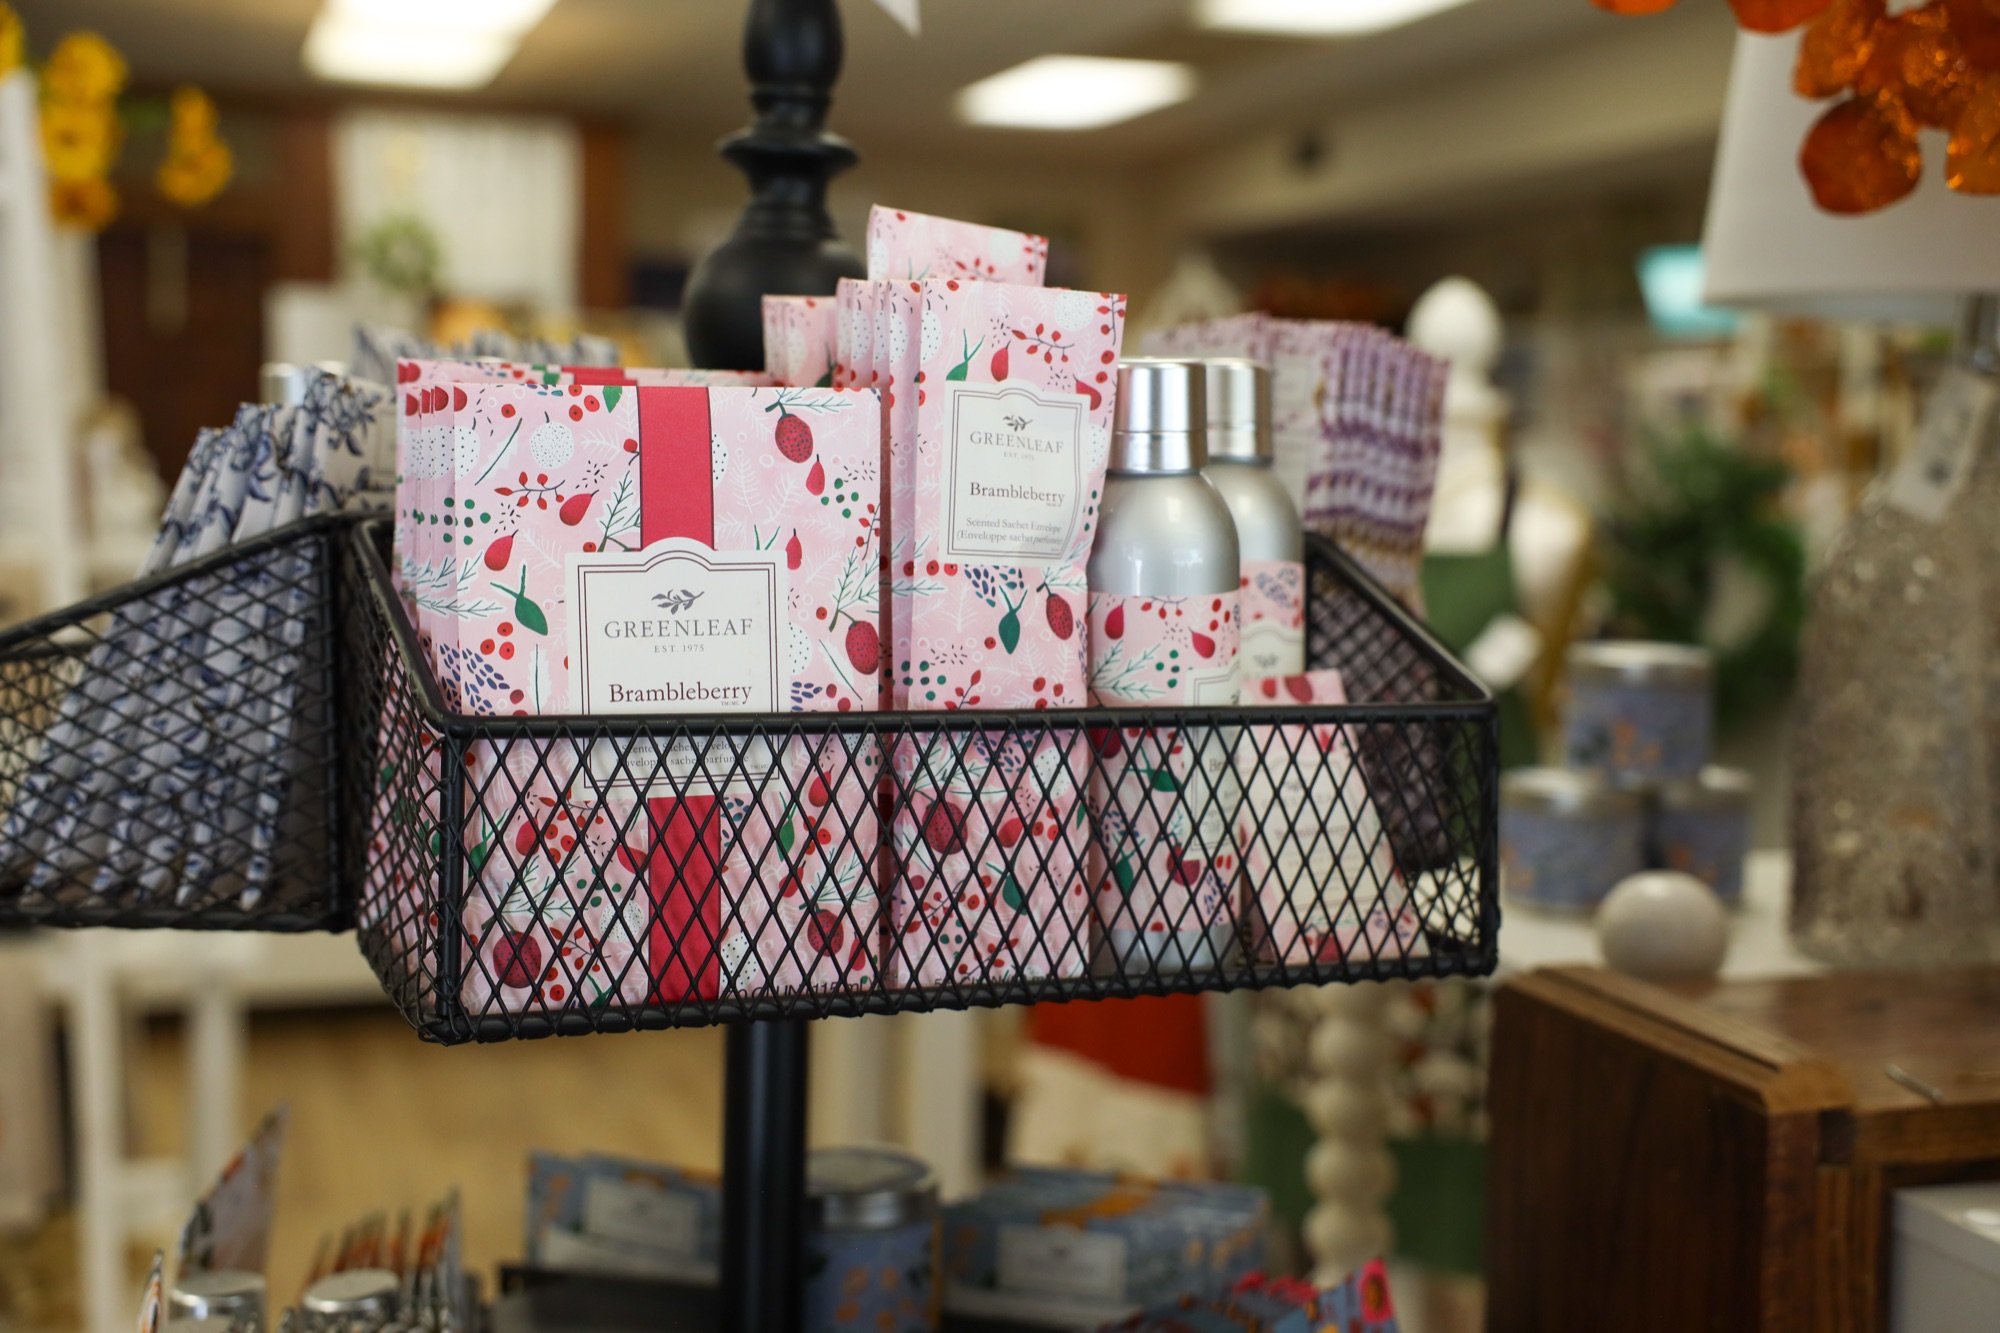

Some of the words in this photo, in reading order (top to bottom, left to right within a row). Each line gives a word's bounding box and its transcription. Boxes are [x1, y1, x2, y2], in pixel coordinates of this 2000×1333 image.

[969, 430, 1064, 454] GREENLEAF
[969, 481, 1065, 507] Brambleberry
[966, 517, 1000, 528] Scented
[1002, 518, 1029, 529] Sachet
[1031, 521, 1062, 535] Envelope
[956, 529, 1007, 543] (Enveloppe
[604, 618, 753, 639] GREENLEAF
[654, 644, 679, 654] EST.
[683, 644, 705, 653] 1975
[609, 681, 753, 705] Brambleberry
[621, 742, 658, 754] Sente
[662, 740, 694, 752] Sche
[697, 739, 742, 751] Eveloe
[670, 755, 698, 766] sache
